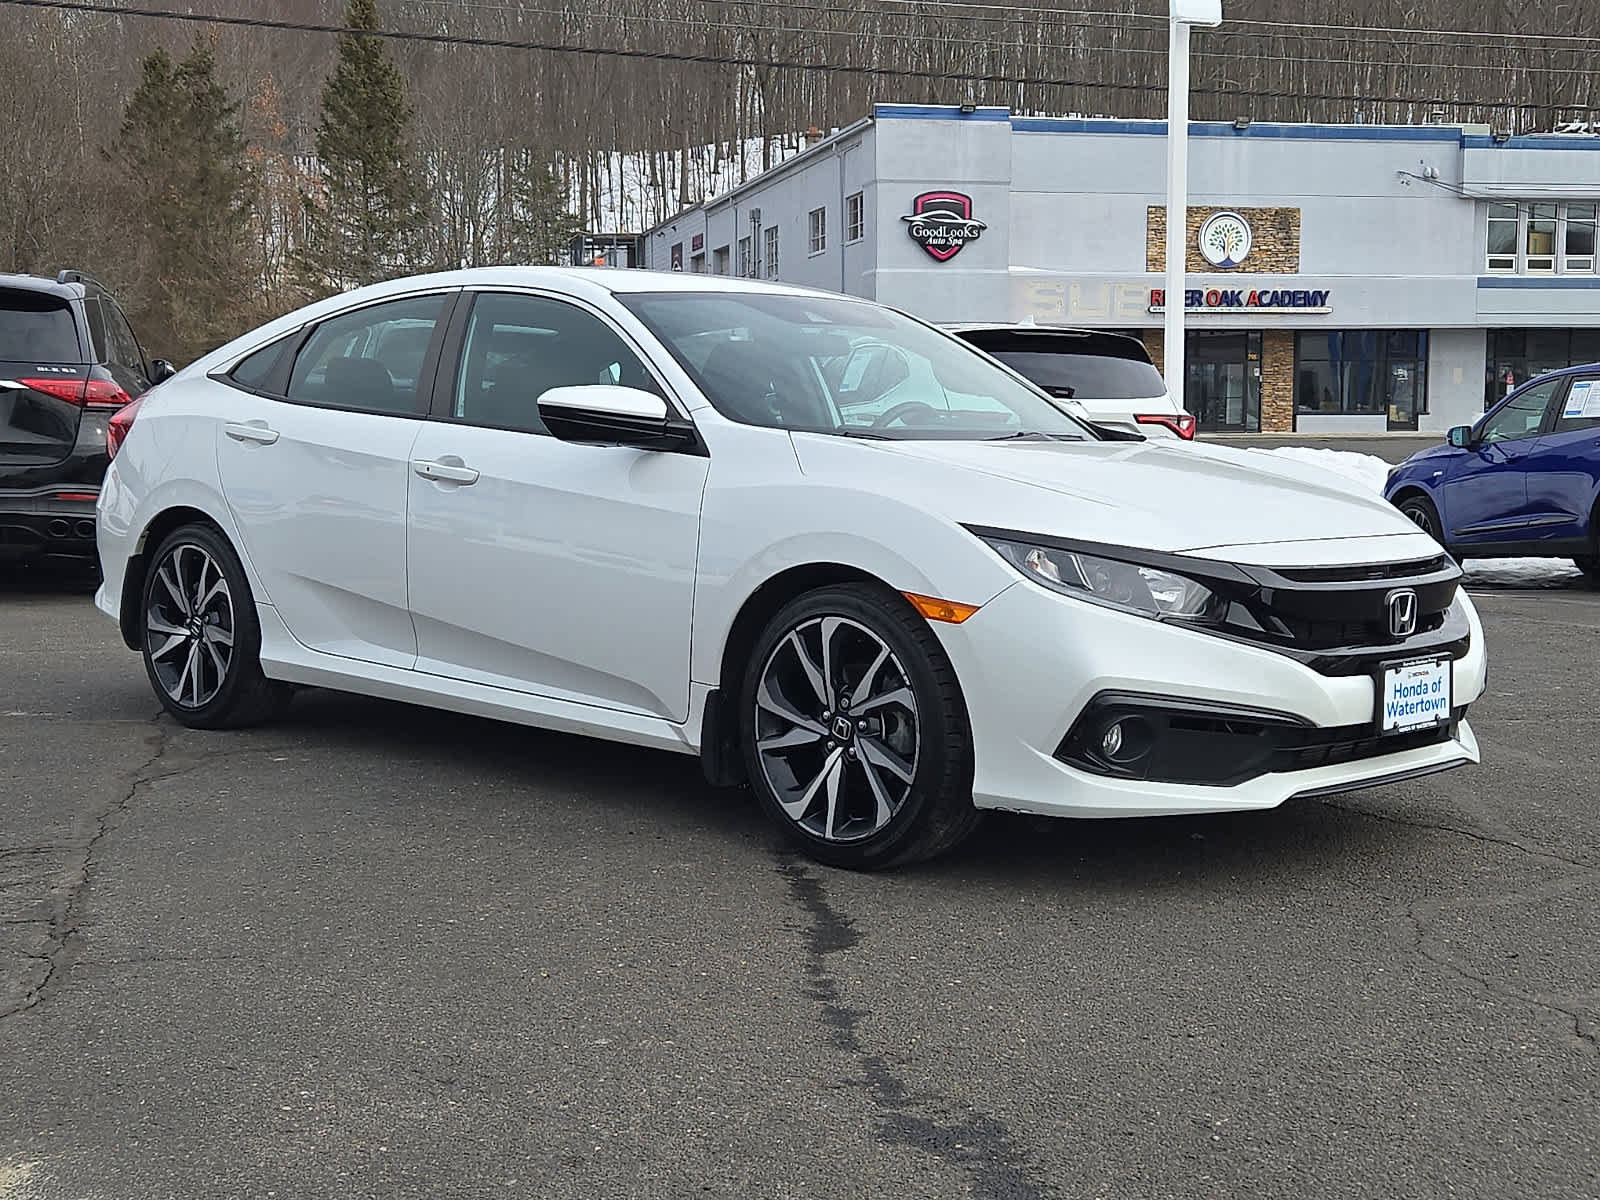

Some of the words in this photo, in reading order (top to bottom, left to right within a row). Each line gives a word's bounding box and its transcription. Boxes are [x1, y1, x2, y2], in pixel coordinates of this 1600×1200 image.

[911, 224, 979, 238] GoodLooKs
[926, 237, 945, 245] Auto
[946, 237, 962, 247] Spa
[1150, 289, 1204, 307] RER
[1206, 289, 1244, 307] OAK
[1246, 289, 1330, 307] ACADEMY
[1393, 679, 1429, 700] Honda
[1431, 676, 1442, 693] of
[1387, 697, 1447, 719] Watertown
